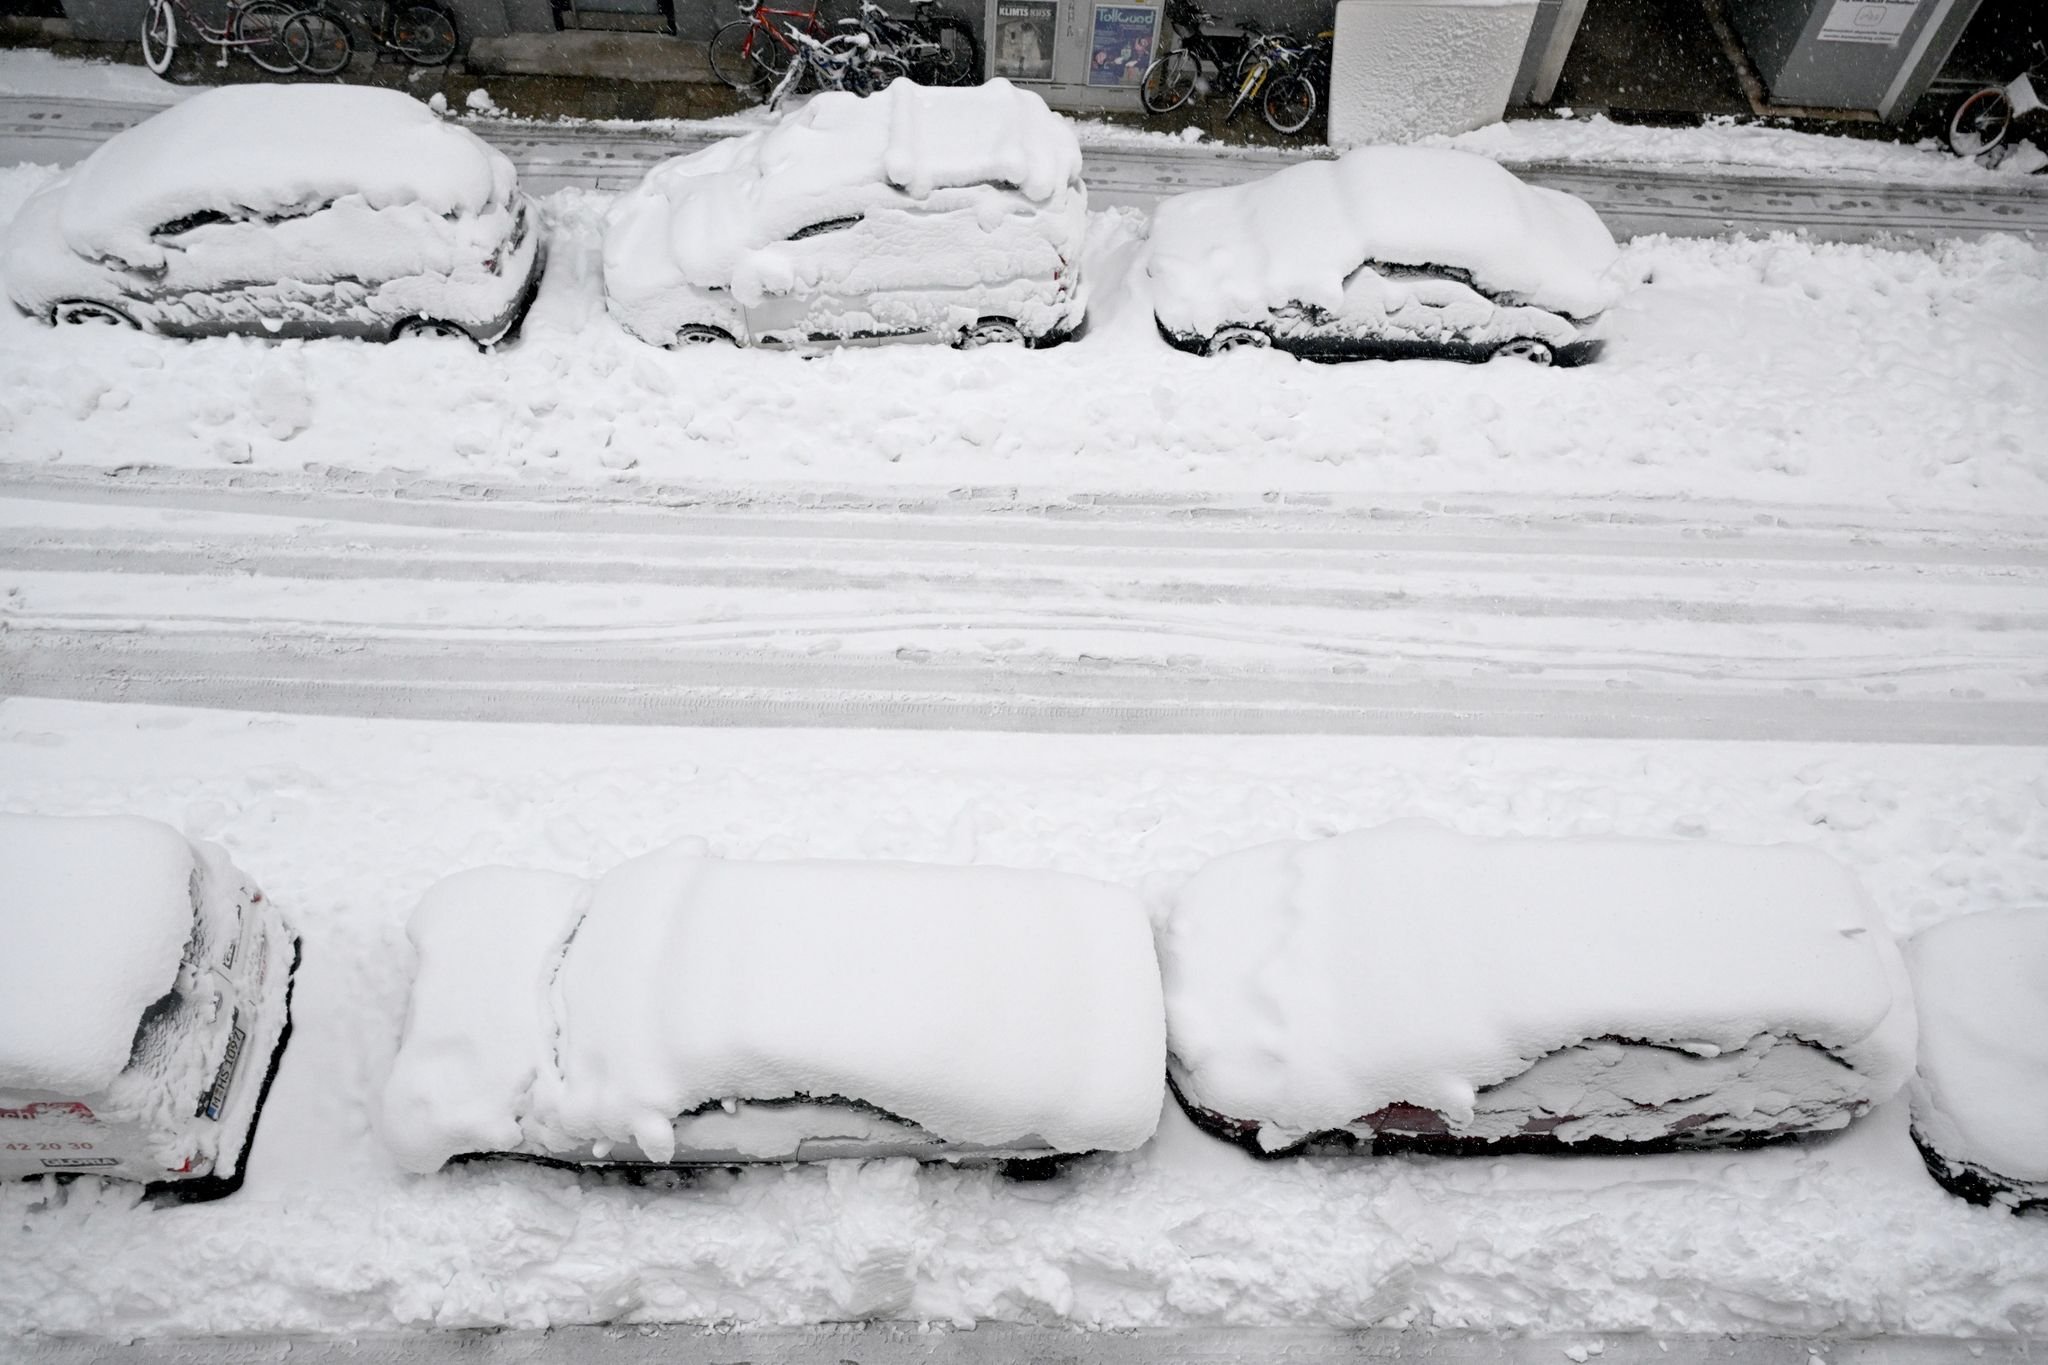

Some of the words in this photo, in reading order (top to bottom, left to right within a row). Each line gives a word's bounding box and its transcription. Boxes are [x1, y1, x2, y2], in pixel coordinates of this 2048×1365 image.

[999, 7, 1028, 17] KLIMTS
[217, 1071, 230, 1090] HS
[6, 1142, 31, 1151] 42
[36, 1142, 62, 1151] 20
[68, 1142, 94, 1150] 30
[42, 1158, 117, 1166] GLORIA
